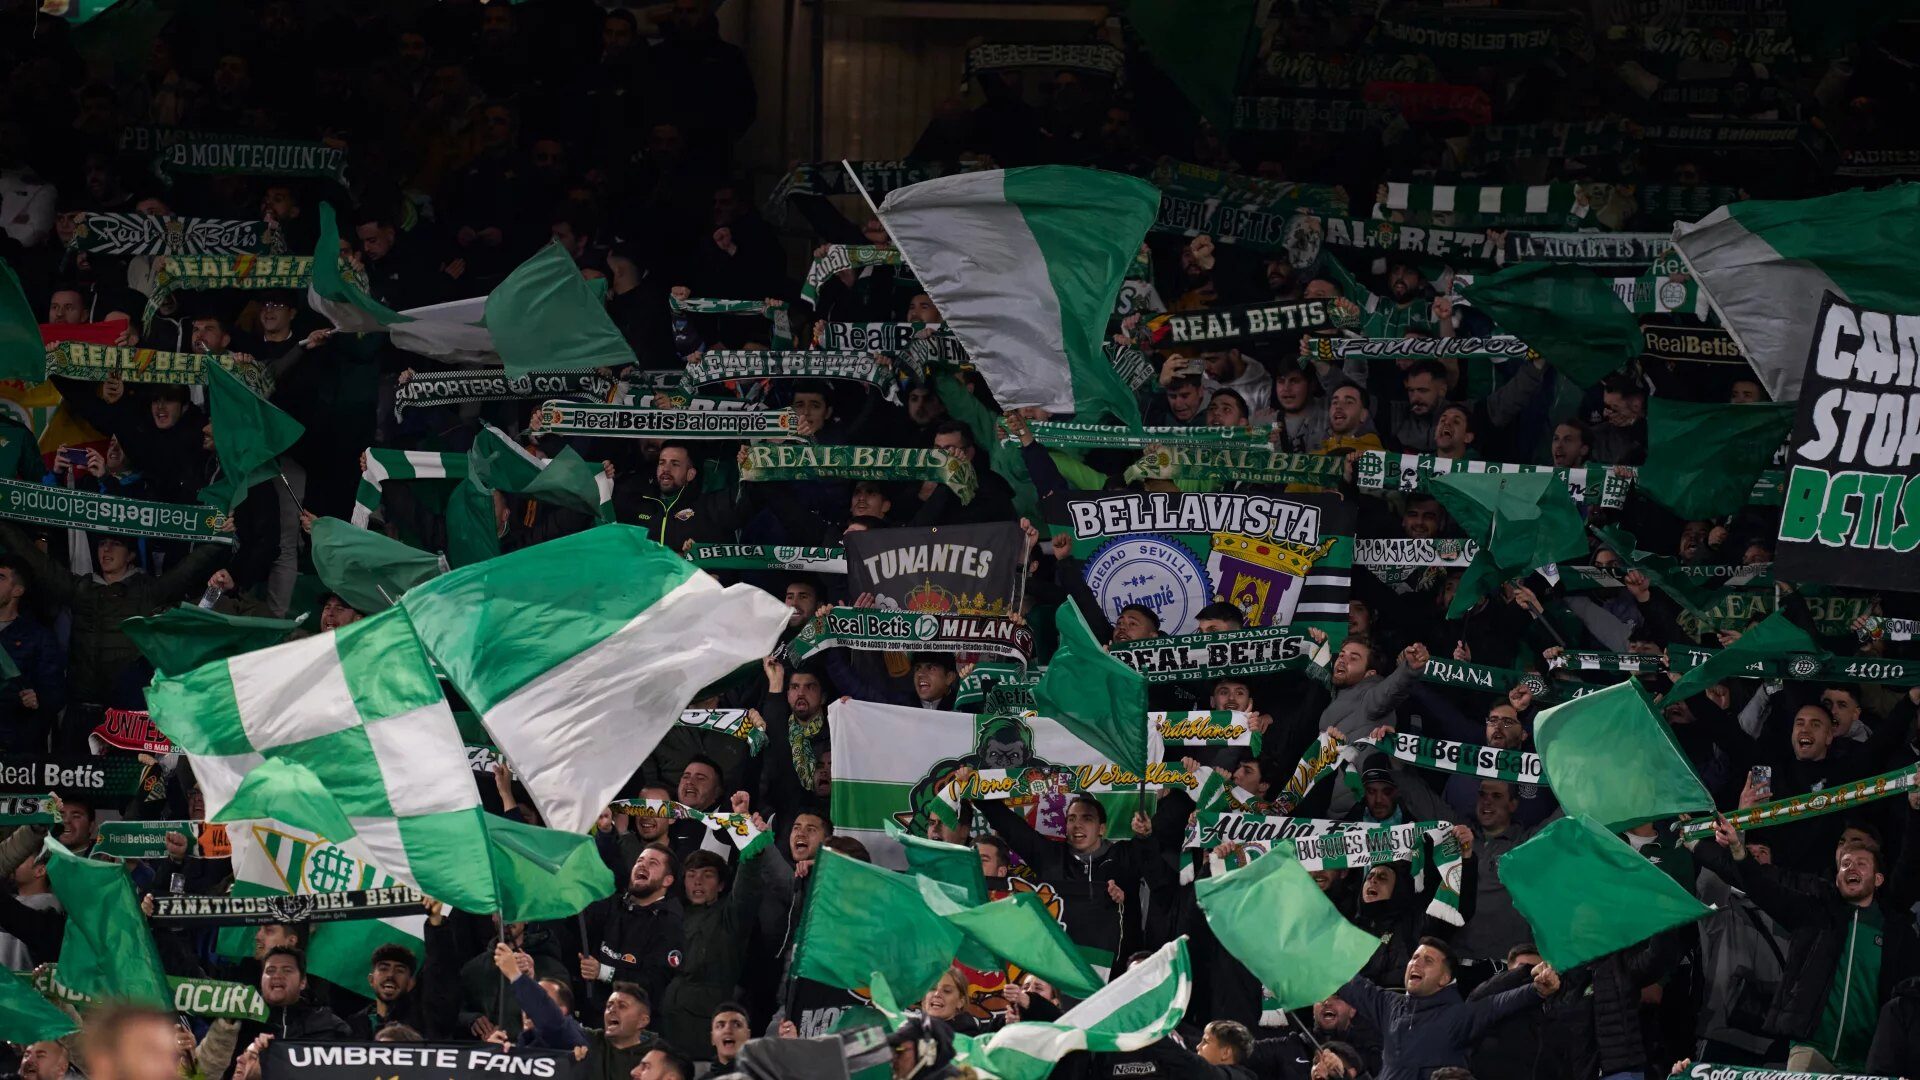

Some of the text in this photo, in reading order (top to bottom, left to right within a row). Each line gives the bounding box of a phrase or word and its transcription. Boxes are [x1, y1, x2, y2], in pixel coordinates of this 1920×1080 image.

[87, 215, 259, 248] Real Betis
[255, 255, 314, 277] BET
[1170, 301, 1327, 343] REAL BETIS
[829, 321, 914, 351] RealB
[156, 350, 236, 371] BETS
[574, 410, 768, 434] RealBetisBalompié
[752, 445, 950, 469] REAL BETIS
[1266, 451, 1345, 475] BETI
[1357, 477, 1382, 487] 1907
[10, 489, 198, 531] RealBetisBalompié
[1068, 493, 1321, 547] BELLAVISTA
[1778, 464, 1920, 552] BETIS
[700, 543, 765, 559] BÉTICA
[1353, 536, 1436, 563] PPORTERS
[863, 543, 994, 587] TUNANTES
[1092, 545, 1193, 598] OCIEDAD SEVILLA
[1803, 596, 1869, 621] BET
[827, 613, 1015, 641] Real Betis MILAN
[1128, 627, 1290, 649] DICEN QUE ESTAMOS
[1110, 635, 1304, 674] REAL BETIS
[1149, 662, 1287, 683] COS DE LA CABEZA
[1424, 659, 1494, 688] TRIANA
[1845, 662, 1905, 679] 41010
[0, 761, 105, 788] Real Betis
[212, 830, 231, 847] VAL
[1297, 834, 1364, 862] BUSQUES
[317, 891, 354, 910] DEL
[365, 886, 423, 906] BETIS
[174, 982, 265, 1016] OCURA
[288, 1046, 556, 1078] UMBRETE FANS
[1114, 1064, 1153, 1074] NORWAY
